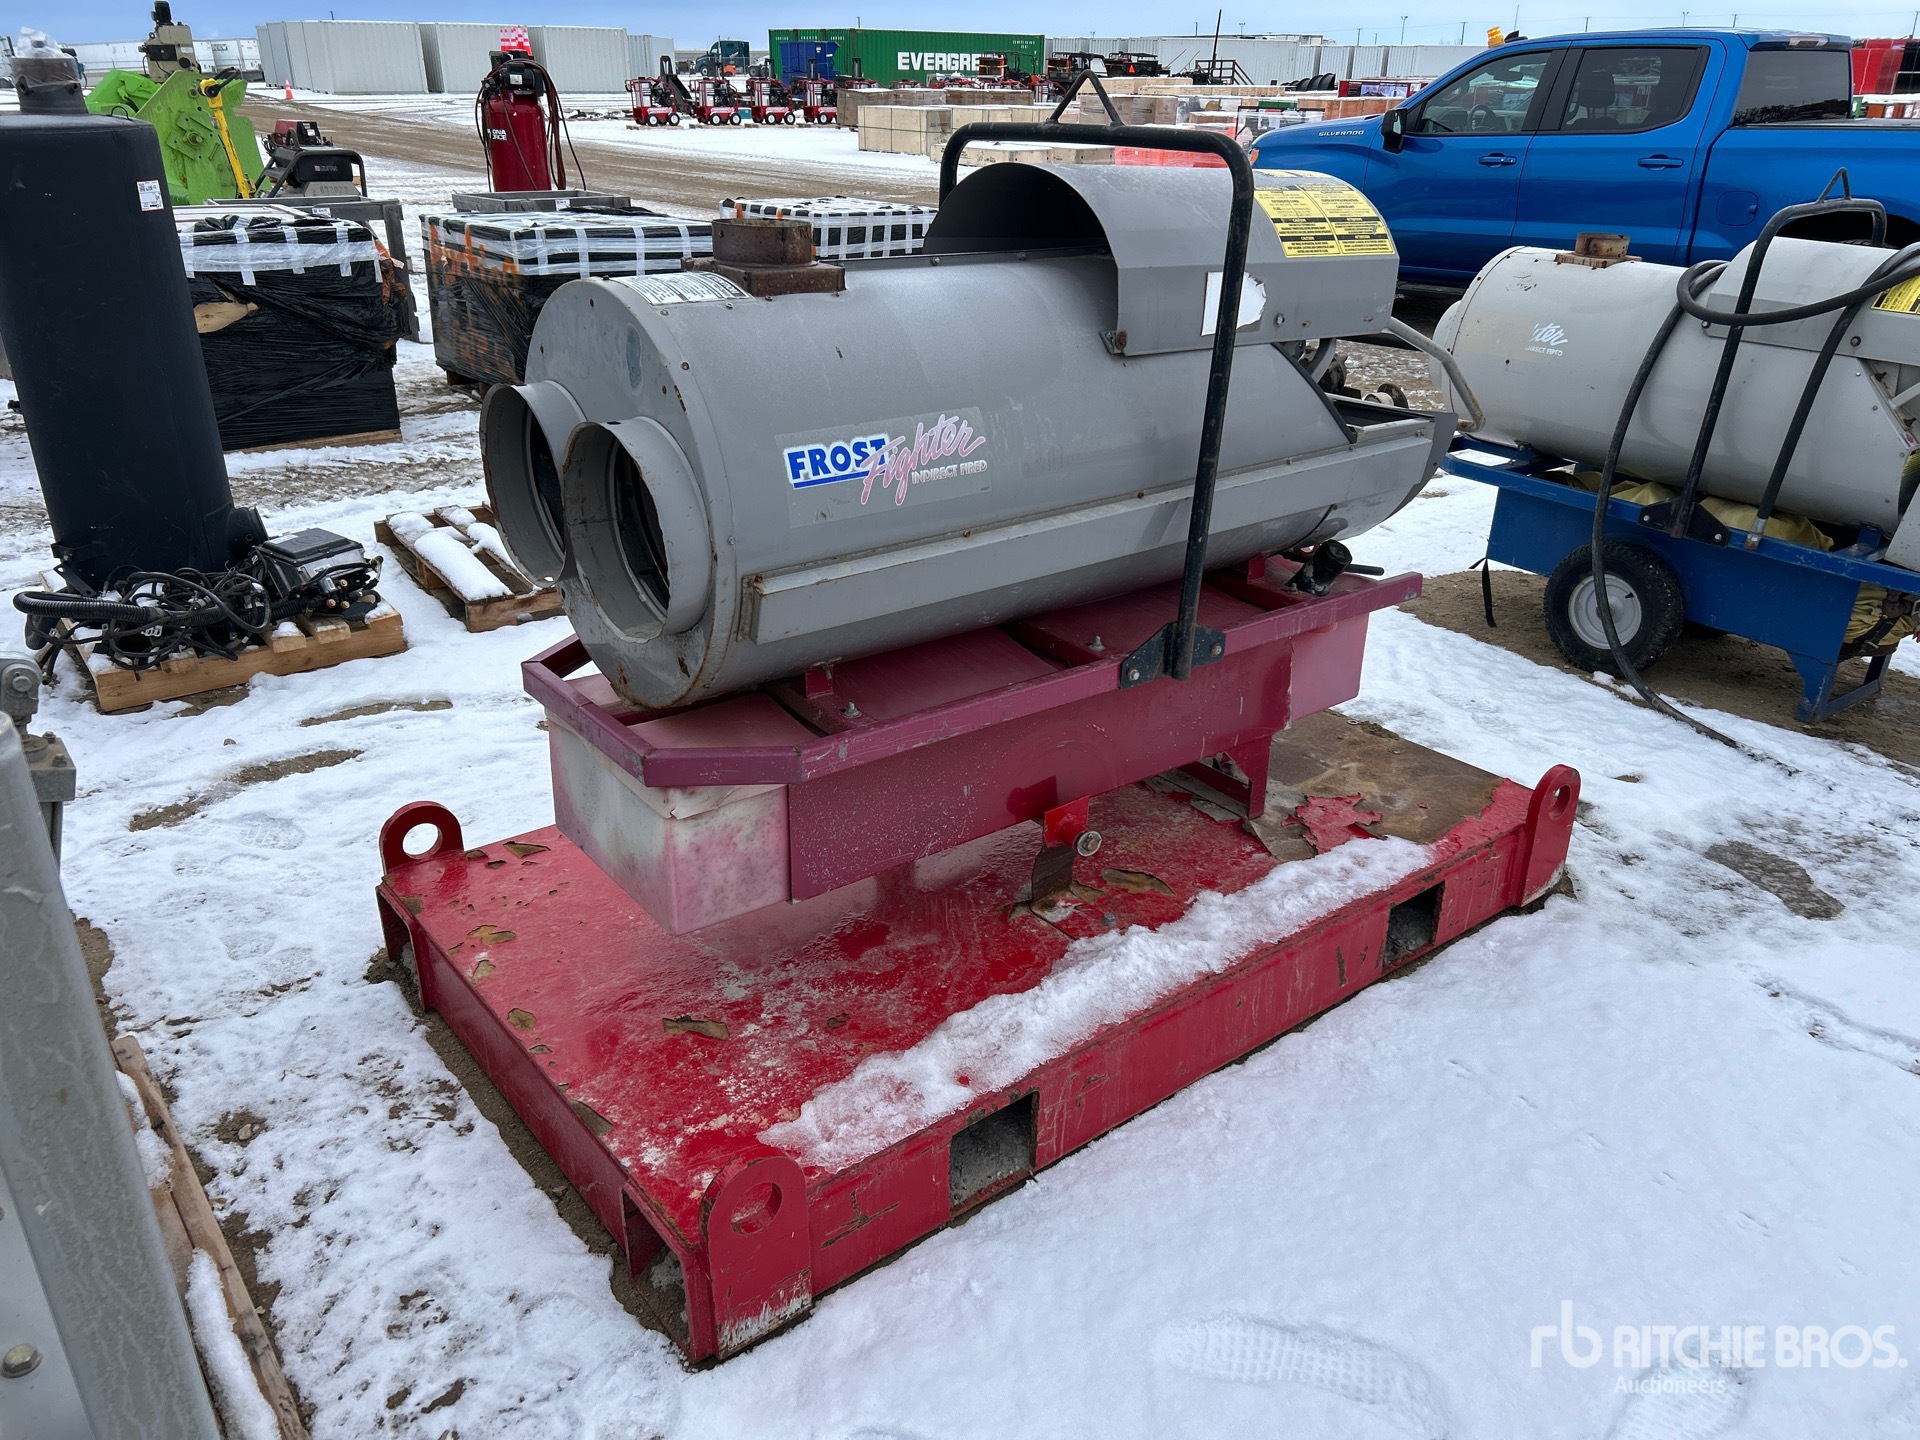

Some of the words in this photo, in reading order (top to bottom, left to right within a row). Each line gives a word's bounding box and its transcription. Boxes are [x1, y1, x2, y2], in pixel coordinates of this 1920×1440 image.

[897, 52, 983, 71] EVERGRE
[786, 436, 888, 481] FROST
[860, 413, 987, 505] Fighter
[911, 464, 958, 485] INDIRECT
[959, 459, 988, 475] FIRED
